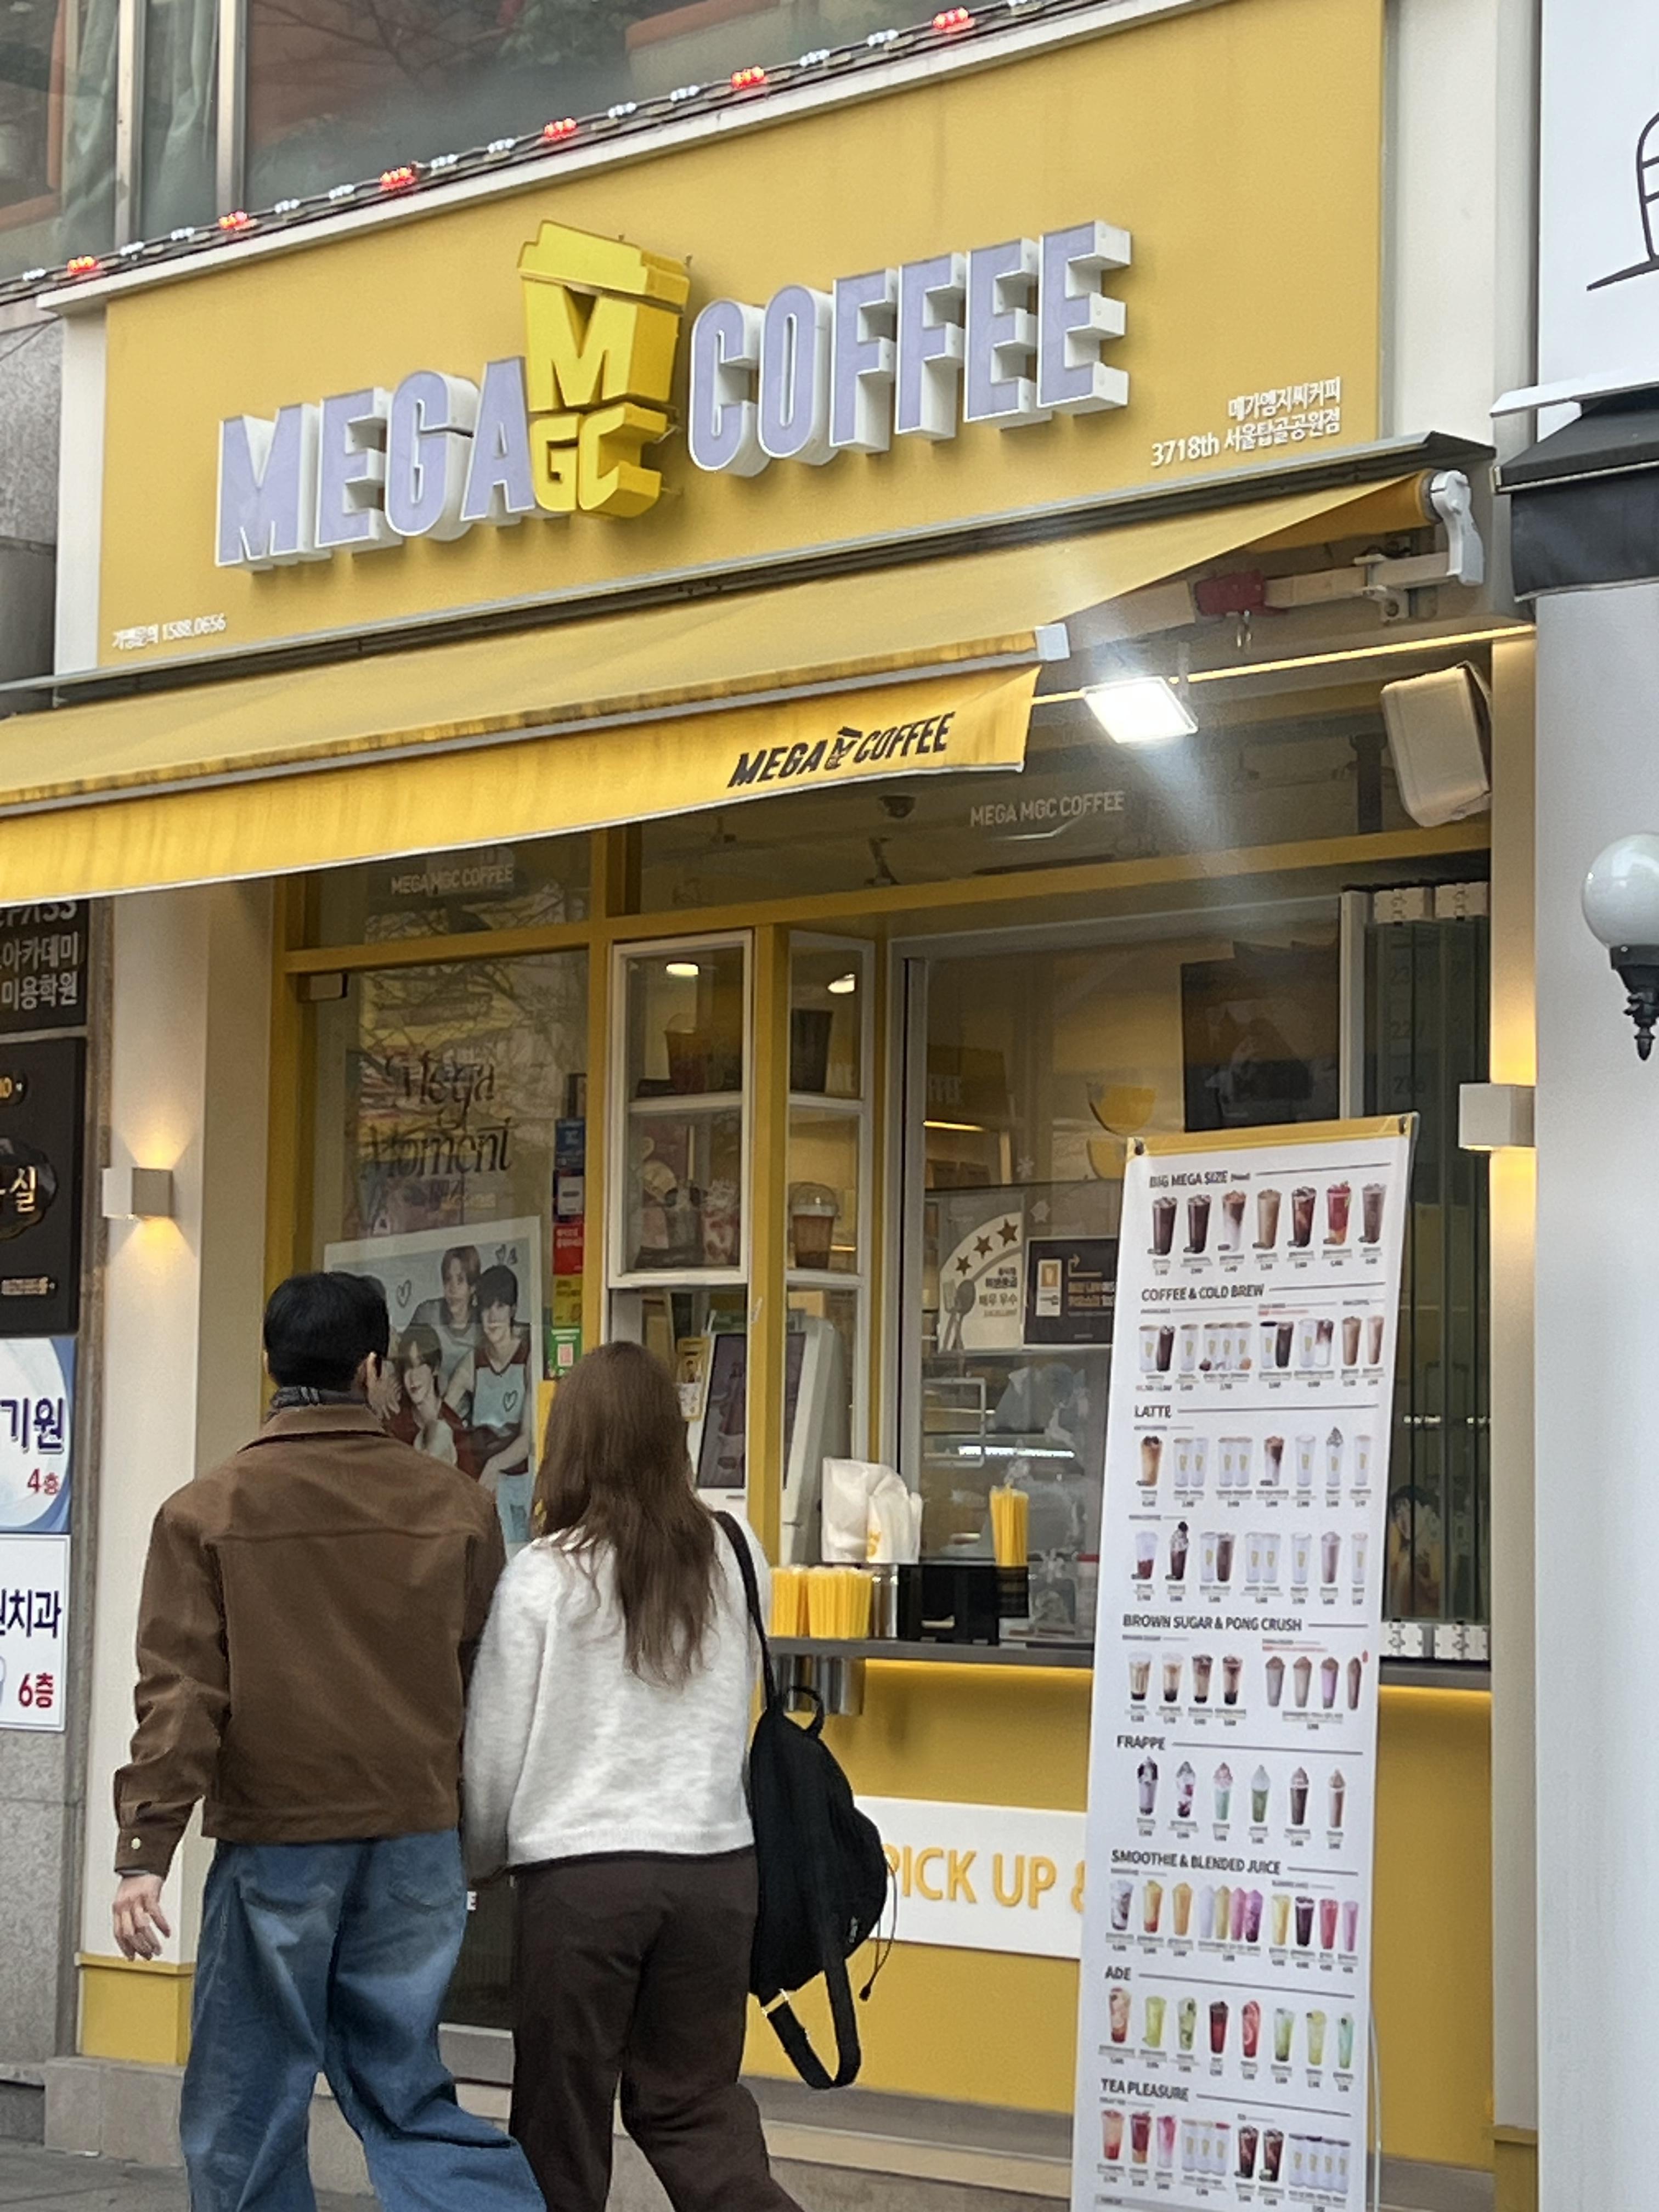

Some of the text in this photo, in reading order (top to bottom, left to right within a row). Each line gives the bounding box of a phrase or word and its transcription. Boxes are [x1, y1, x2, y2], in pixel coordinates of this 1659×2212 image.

[215, 356, 535, 571] MEGA
[689, 219, 1131, 477] COFFEE
[1228, 376, 1340, 421] 메가엠지씨커피
[1150, 407, 1340, 468] 3718th 서울탑골공원점
[727, 739, 828, 788] MEGA
[853, 712, 956, 763] COFFEE
[970, 790, 1125, 827] MEGA MGC COFFEE
[391, 873, 427, 896] MEGA
[462, 864, 514, 887] COFFEE
[0, 931, 78, 973] 아카데미
[2, 970, 77, 1011] 미용학원
[0, 1166, 36, 1213] 실
[1172, 1172, 1201, 1186] MEGA
[1205, 1170, 1228, 1185] SIZE
[1142, 1286, 1187, 1302] COFFEE
[1198, 1285, 1228, 1299] COLD
[1231, 1284, 1264, 1297] BREW
[0, 1398, 64, 1453] 기원
[1134, 1404, 1171, 1419] LATTE
[1122, 1613, 1171, 1628] BROWN
[1173, 1615, 1213, 1629] SUGAR
[1226, 1617, 1260, 1631] PONG
[1261, 1617, 1302, 1632] CRUSH
[18, 1673, 54, 1708] 6층
[1116, 1735, 1166, 1751] FRAPPE
[1111, 1849, 1178, 1866] SMOOTHIE
[1190, 1856, 1245, 1872] BLENDED
[1247, 1860, 1281, 1875] JUICE
[992, 1852, 1057, 1909] UP
[1105, 1966, 1131, 1981] ADE
[1101, 2077, 1125, 2094] TEA
[1127, 2081, 1189, 2102] PLEASURE
